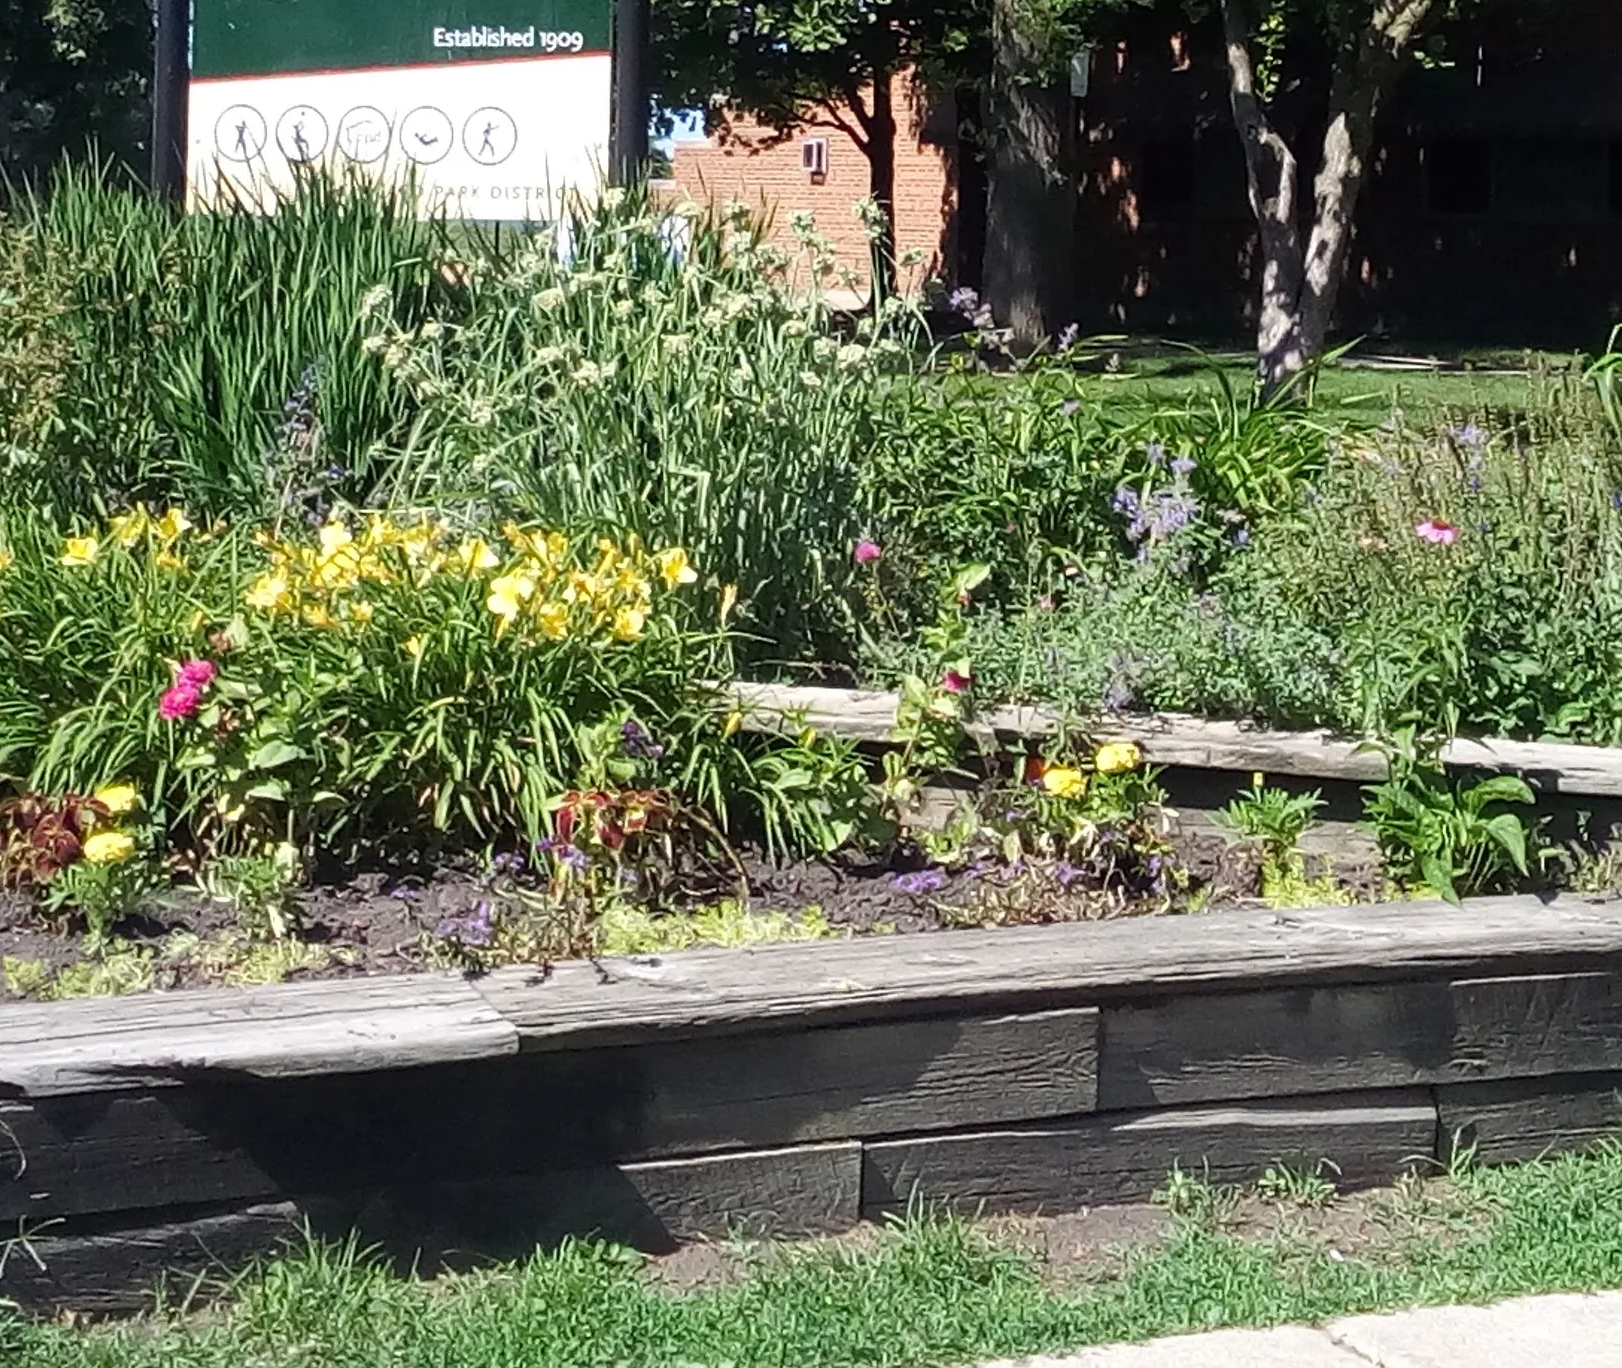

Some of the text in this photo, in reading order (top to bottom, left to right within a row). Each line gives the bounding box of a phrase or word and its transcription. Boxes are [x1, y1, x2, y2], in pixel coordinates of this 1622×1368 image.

[433, 25, 584, 52] Established 1909
[434, 185, 480, 200] PARK
[490, 185, 578, 201] DISTRCT
